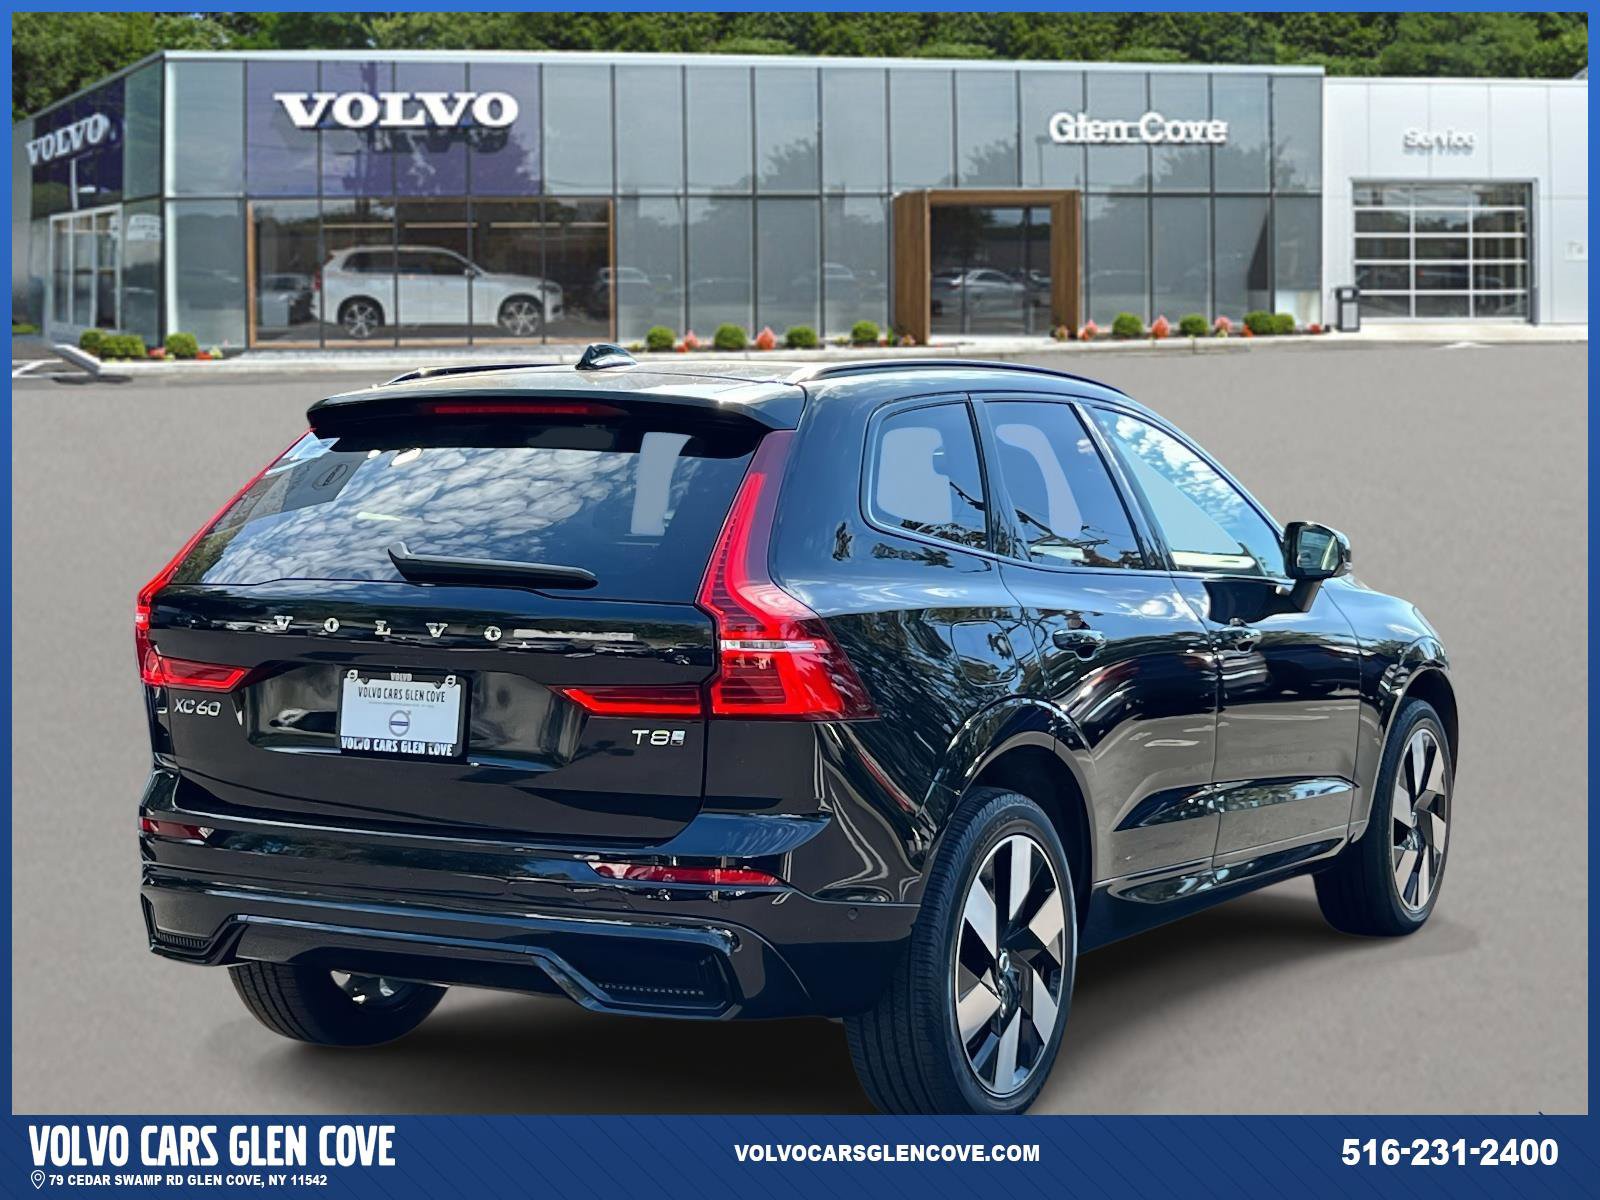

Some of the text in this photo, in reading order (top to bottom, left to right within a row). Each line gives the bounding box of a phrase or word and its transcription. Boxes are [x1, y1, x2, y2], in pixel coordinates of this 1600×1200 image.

[274, 92, 519, 127] VOLVO
[1049, 112, 1228, 143] Glen Cove
[25, 113, 110, 166] VOLVO
[1402, 127, 1476, 151] Service
[273, 614, 503, 642] VOLVO
[390, 672, 413, 682] VOLVO
[358, 686, 446, 703] VOLVO CARS GLEN COVE
[173, 698, 221, 717] XC60
[341, 736, 453, 757] VOLVO CARS GLEN COVE
[631, 729, 671, 746] T8
